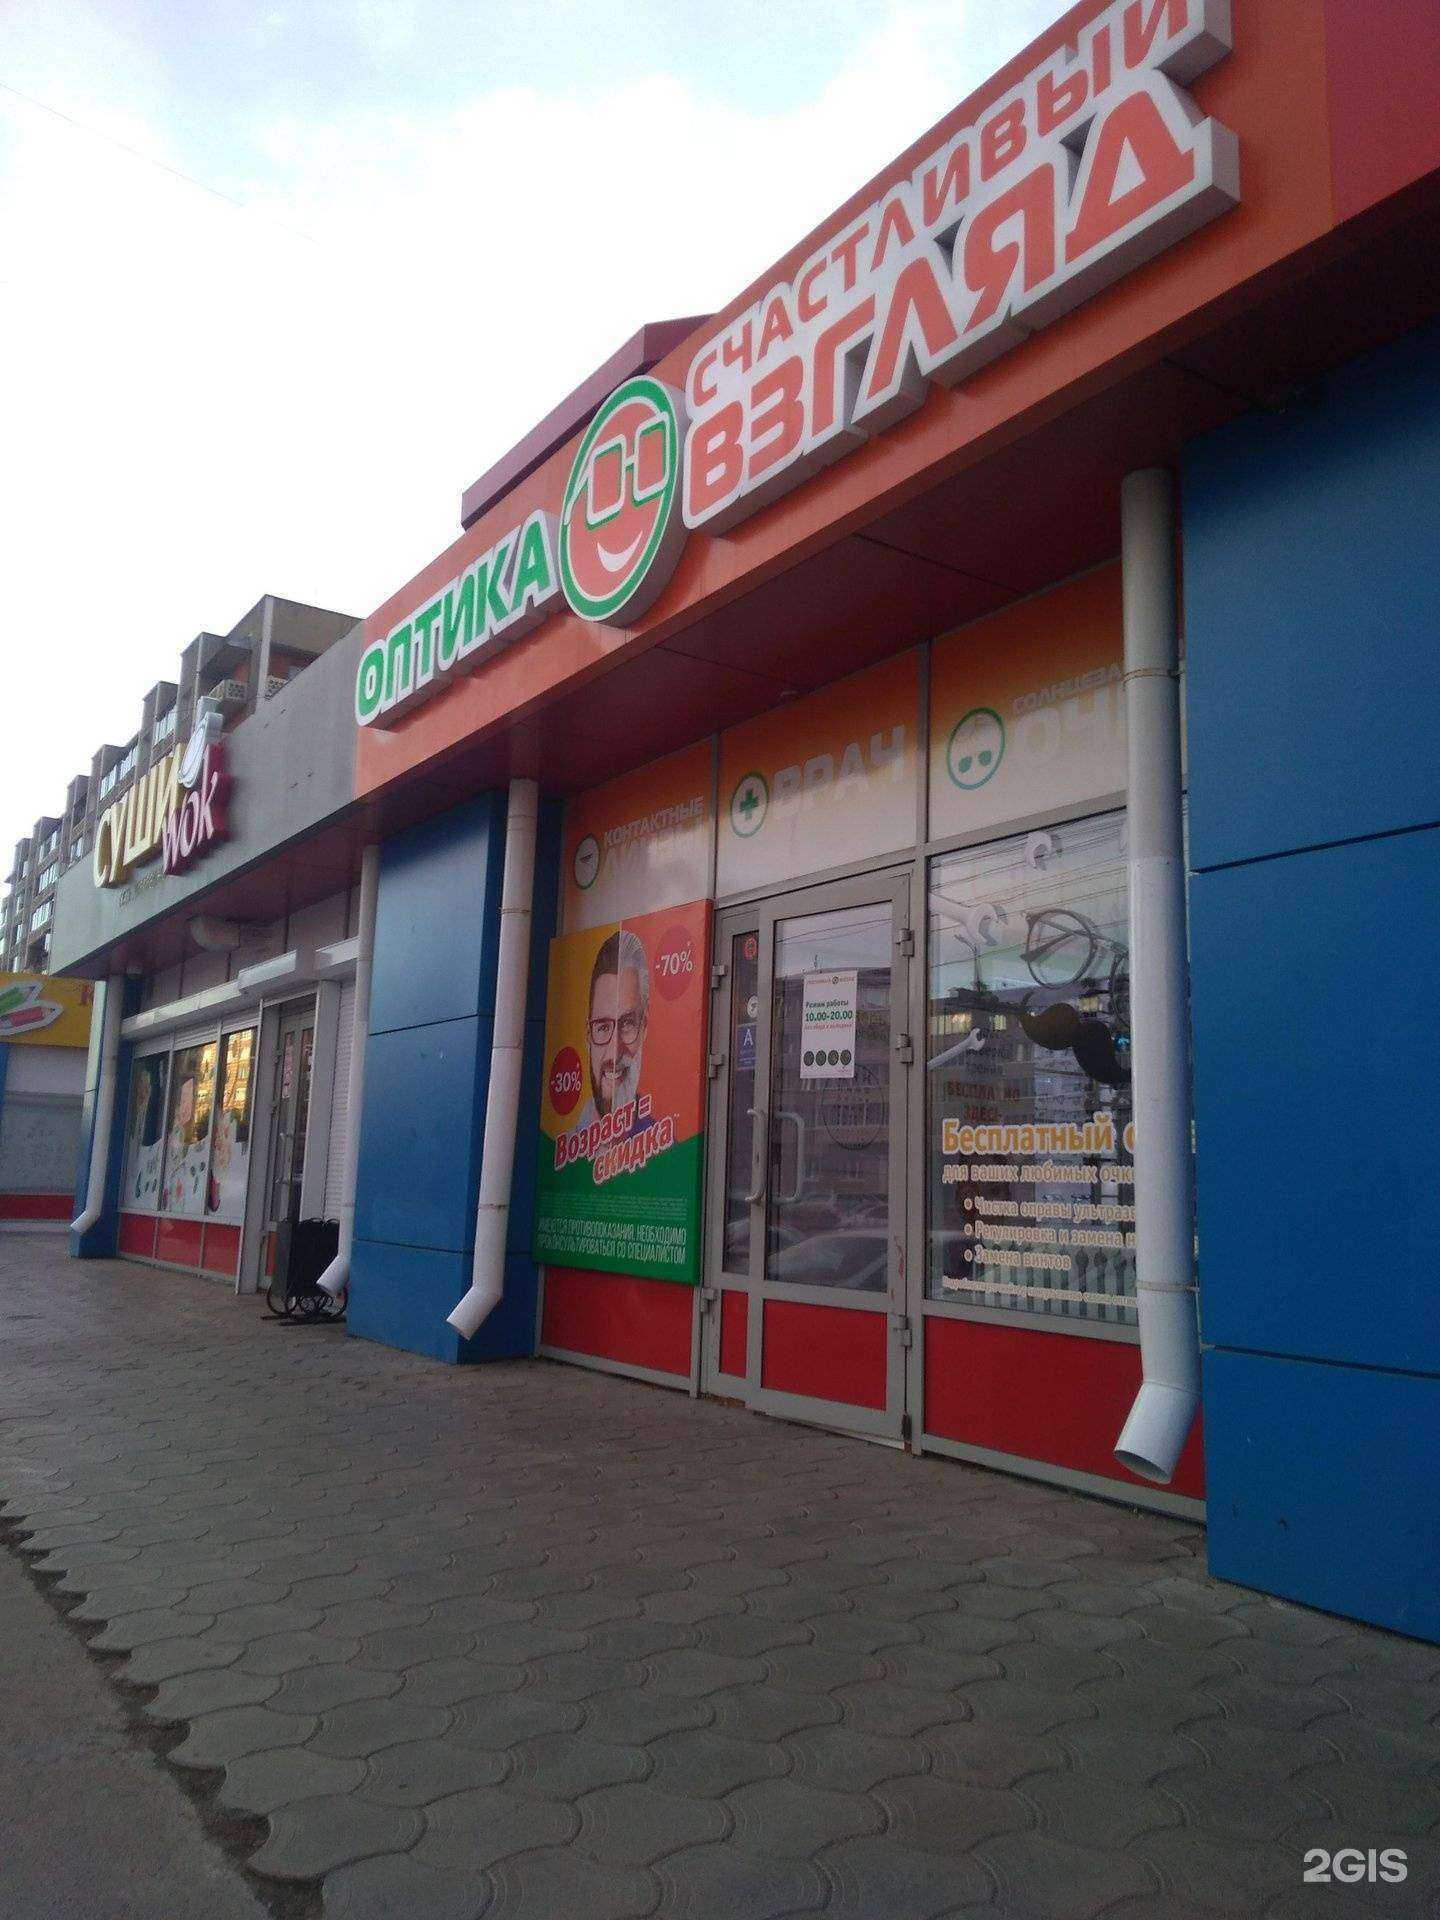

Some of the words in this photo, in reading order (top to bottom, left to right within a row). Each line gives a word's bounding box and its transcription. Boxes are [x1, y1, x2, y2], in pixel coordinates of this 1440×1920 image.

[688, 89, 1198, 518] ВЗГЛЯД
[356, 515, 556, 722] ОПТИКА
[94, 742, 187, 888] СУШИ
[805, 1010, 853, 1022] 10.00-20.00
[554, 1099, 636, 1172] Возраст
[593, 1117, 675, 1185] скидка
[942, 1112, 1116, 1155] Бесплатный
[942, 1164, 969, 1184] для
[970, 1164, 1018, 1183] ваших
[1020, 1161, 1098, 1184] любимых
[1071, 1229, 1123, 1247] замена
